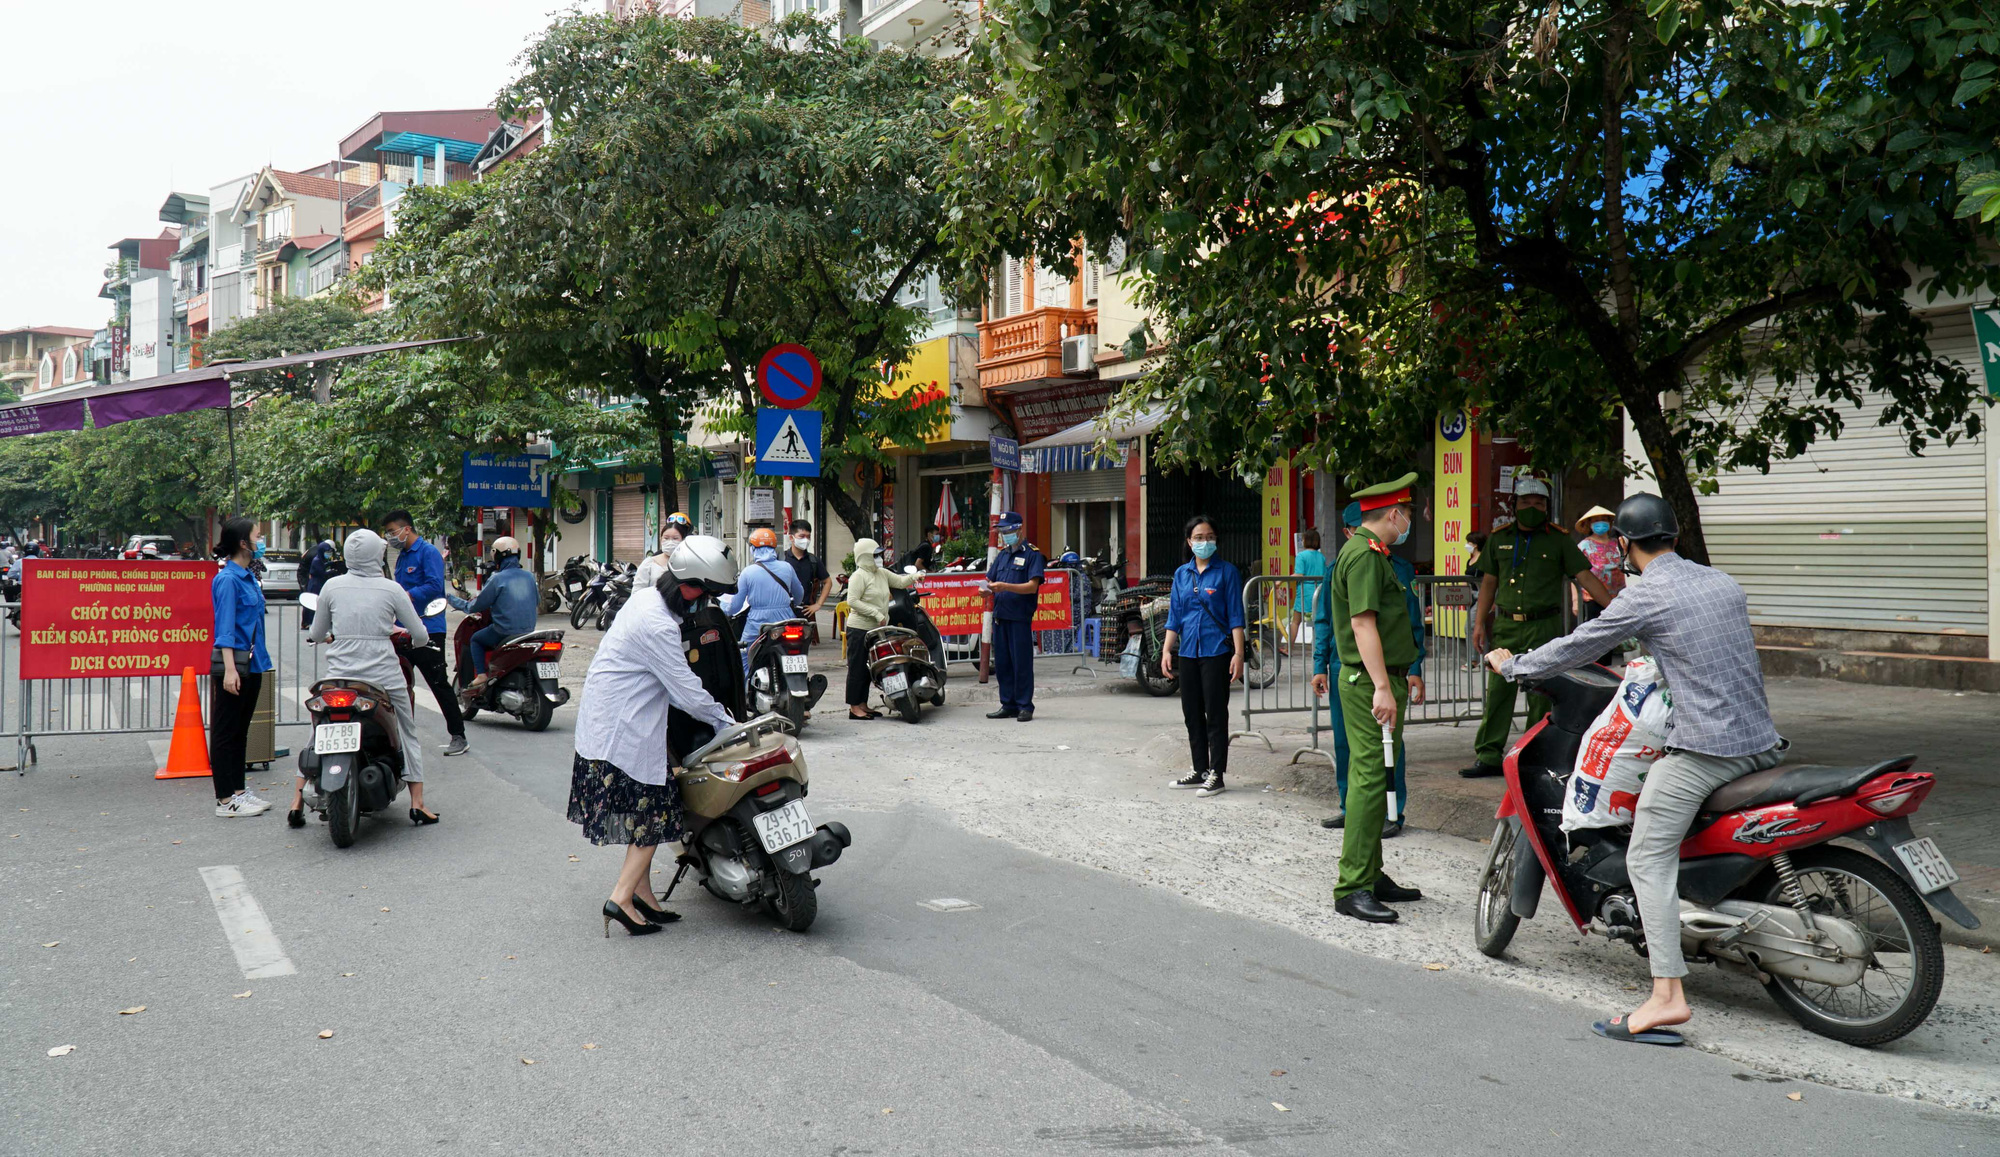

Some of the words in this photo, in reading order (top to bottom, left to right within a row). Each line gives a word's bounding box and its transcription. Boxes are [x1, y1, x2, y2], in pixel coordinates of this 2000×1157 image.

[998, 442, 1008, 454] NGÕ
[1444, 448, 1462, 474] BÚN
[1268, 464, 1282, 486] BÚN
[1270, 494, 1280, 516] CÁ
[1446, 482, 1458, 508] CÁ
[1268, 527, 1282, 547] CAY
[1444, 520, 1461, 542] CAY
[1269, 552, 1281, 576] HẢI
[1445, 548, 1460, 576] HẢI
[36, 570, 54, 579] BAN
[56, 568, 70, 579] CHỈ
[72, 570, 88, 580] ĐẠO
[90, 568, 120, 580] PHÒNG,
[122, 568, 148, 579] CHỐNG
[171, 571, 206, 580] COVID-19
[79, 582, 112, 592] PHƯỜNG
[114, 584, 136, 594] NGỌC
[138, 582, 165, 592] KHÁNH
[1044, 590, 1062, 604] NGƯỜI
[71, 600, 108, 620] CHỐT
[111, 604, 130, 619] CƠ
[133, 602, 172, 622] ĐỘNG
[928, 597, 940, 611] VỰC
[942, 593, 956, 608] CẤM
[957, 596, 969, 609] HỌP
[936, 611, 948, 626] BẢO
[950, 612, 966, 625] CÔNG
[968, 612, 979, 624] TÁC
[1039, 610, 1065, 621] COVID-19
[30, 623, 66, 644] KIỂM
[70, 626, 108, 646] SOÁT,
[112, 627, 159, 643] PHÒNG
[162, 623, 208, 642] CHỐNG
[70, 656, 104, 673] DỊCH
[108, 654, 170, 669] COVID-19
[324, 725, 353, 738] 17-B9
[318, 738, 357, 751] 365.59
[762, 804, 800, 831] 29-P1
[765, 820, 812, 849] 636.72
[789, 848, 806, 862] 501
[1902, 840, 1939, 866] 29-Y2
[1919, 861, 1954, 887] 1542
